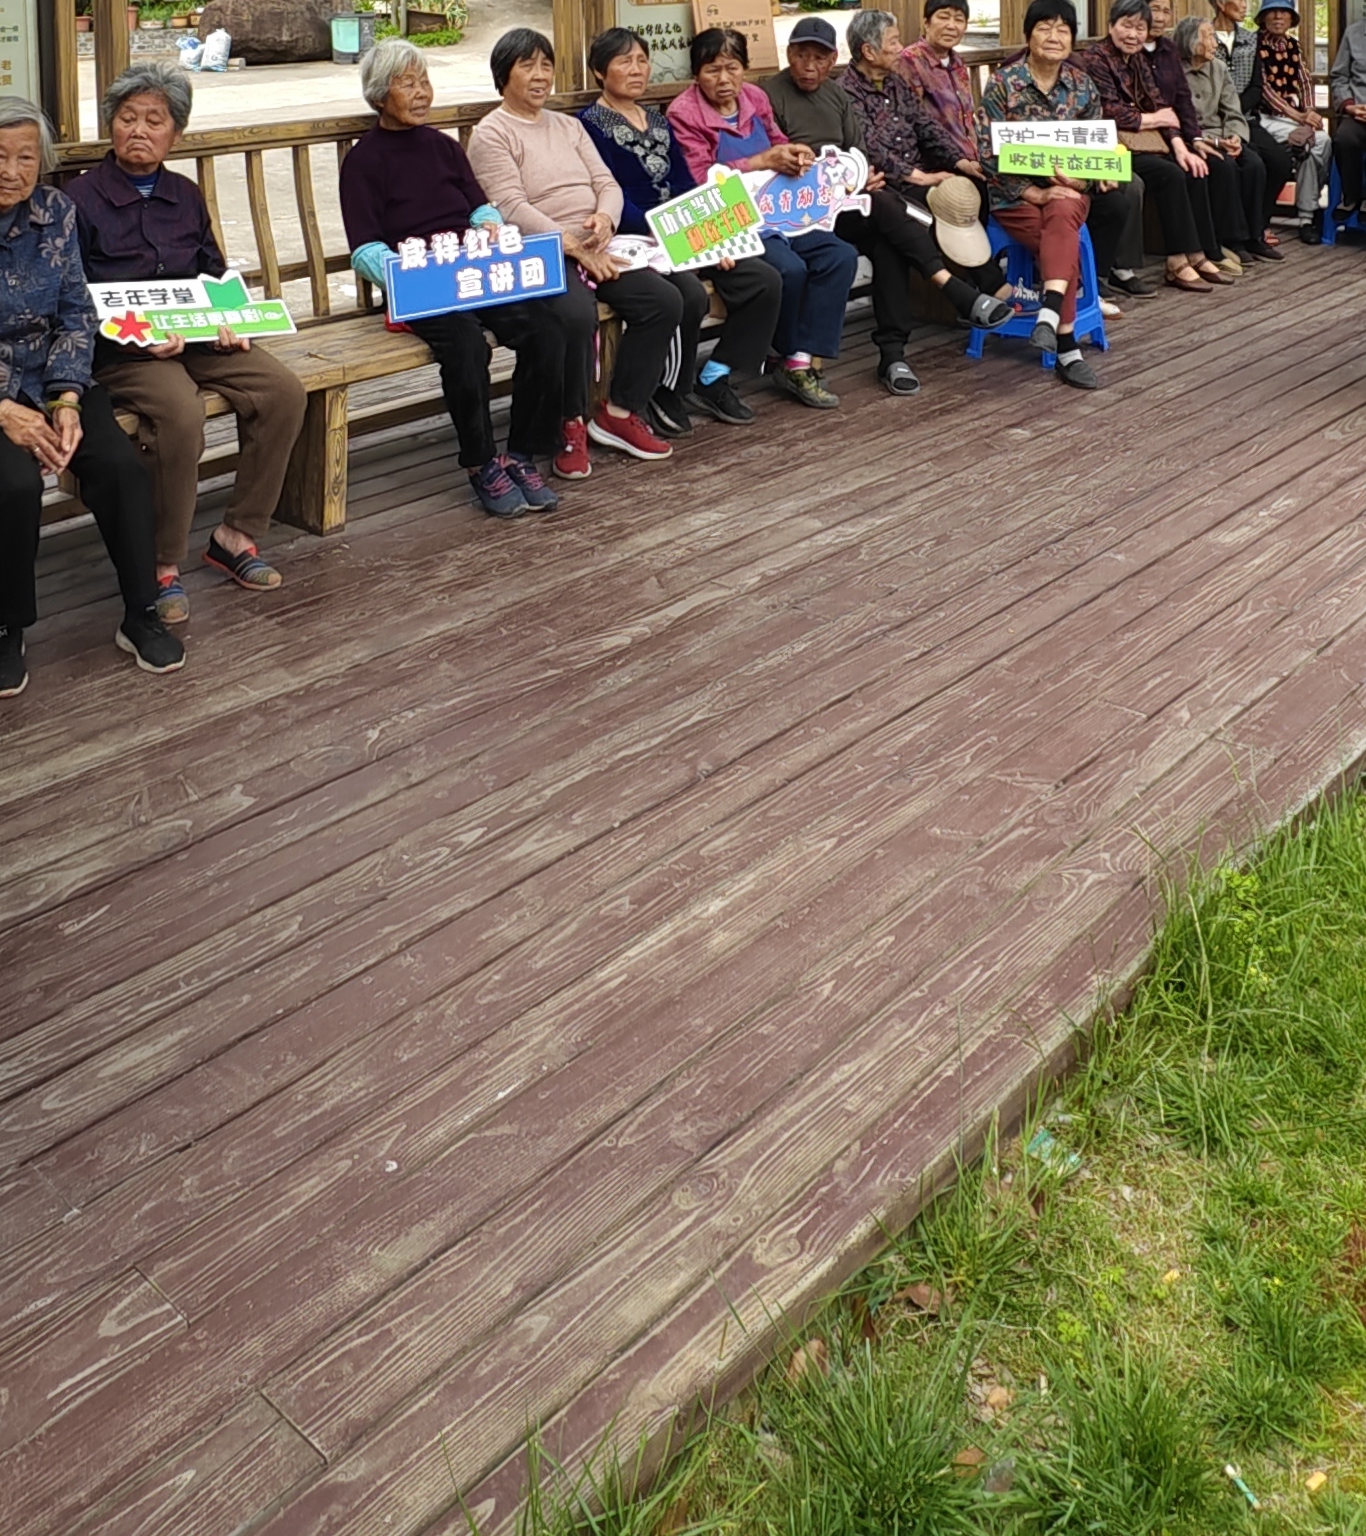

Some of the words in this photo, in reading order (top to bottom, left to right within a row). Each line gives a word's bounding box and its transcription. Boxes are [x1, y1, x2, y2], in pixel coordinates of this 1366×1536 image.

[997, 127, 1109, 145] 守护一方青绿
[1009, 152, 1123, 173] 收获生态红利
[398, 224, 524, 270] 咸祥红色
[456, 257, 546, 300] 宣讲团
[100, 287, 196, 308] 老年学堂
